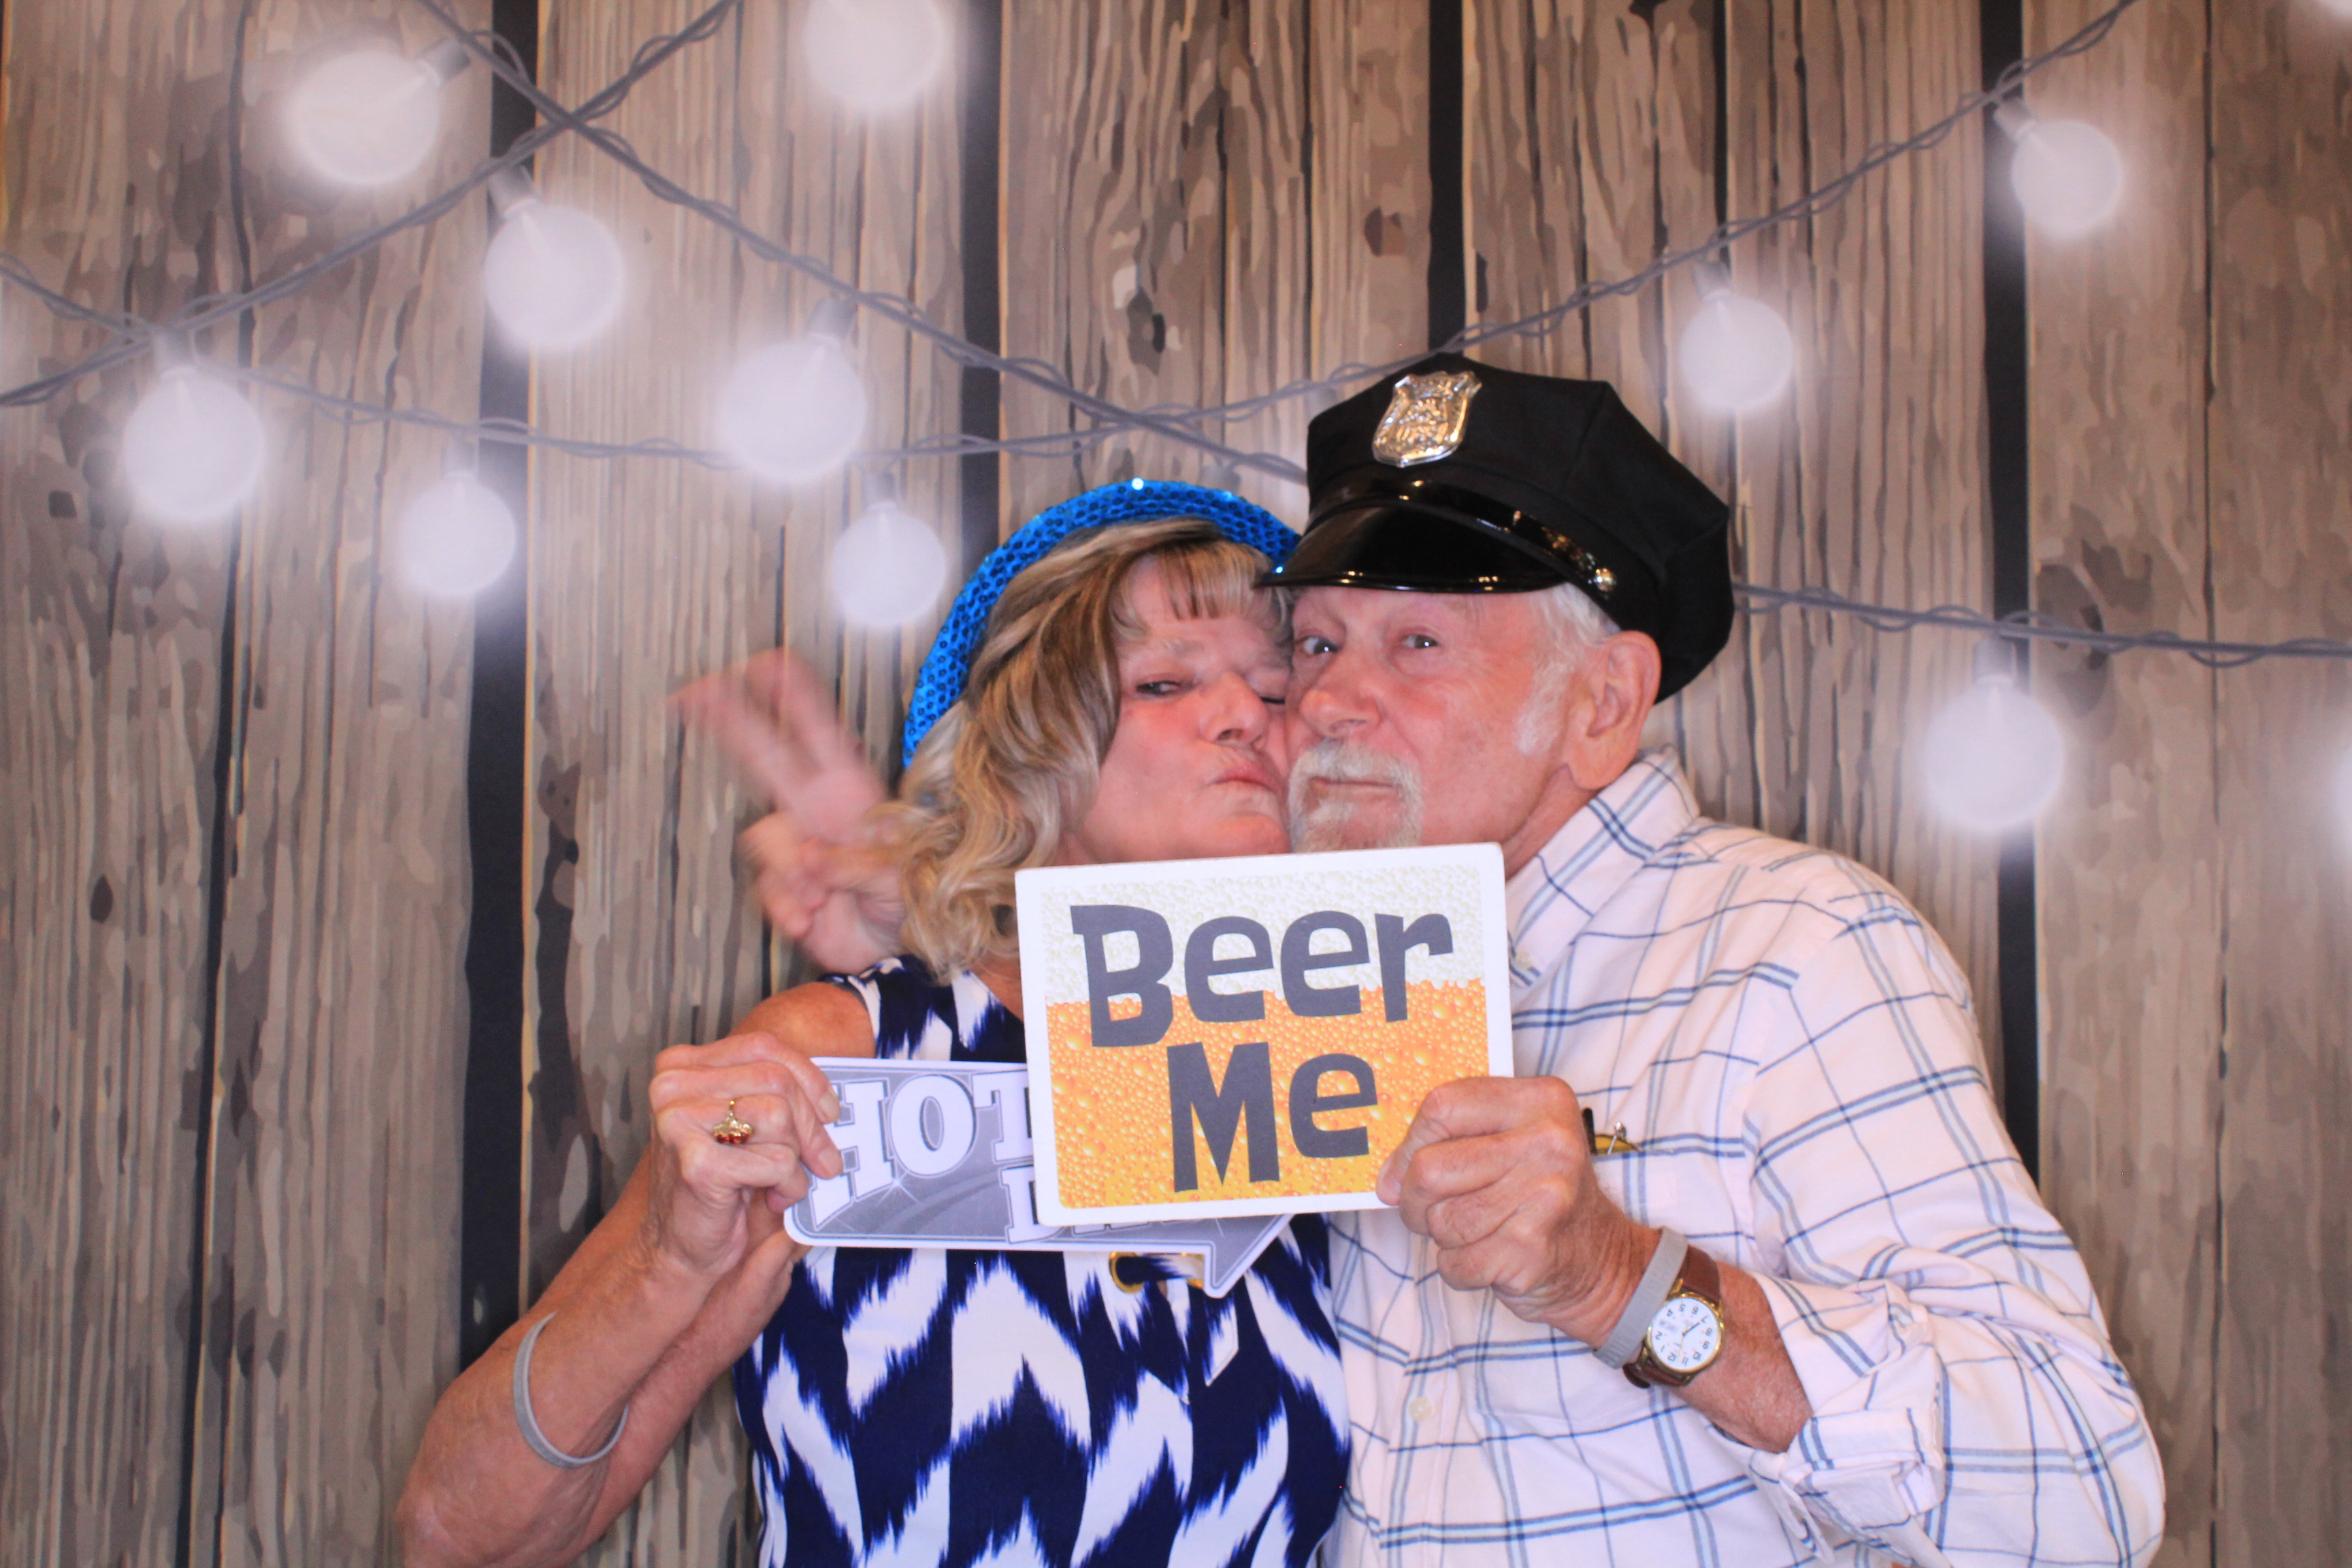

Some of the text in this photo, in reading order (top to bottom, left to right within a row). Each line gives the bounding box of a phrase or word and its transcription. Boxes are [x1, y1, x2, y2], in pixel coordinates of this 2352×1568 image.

[1070, 904, 1453, 1047] Beer
[1166, 1041, 1377, 1192] Me
[811, 1068, 1032, 1230] HOT
[1679, 1303, 1686, 1312] 5
[1691, 1306, 1699, 1315] 6
[1667, 1309, 1673, 1317] 4
[1701, 1314, 1711, 1324] 7
[1655, 1331, 1663, 1340] 2
[1705, 1327, 1712, 1336] 8
[1703, 1341, 1710, 1350] 9
[1667, 1352, 1677, 1362] 12
[1693, 1352, 1701, 1360] 10
[1682, 1356, 1688, 1366] 11
